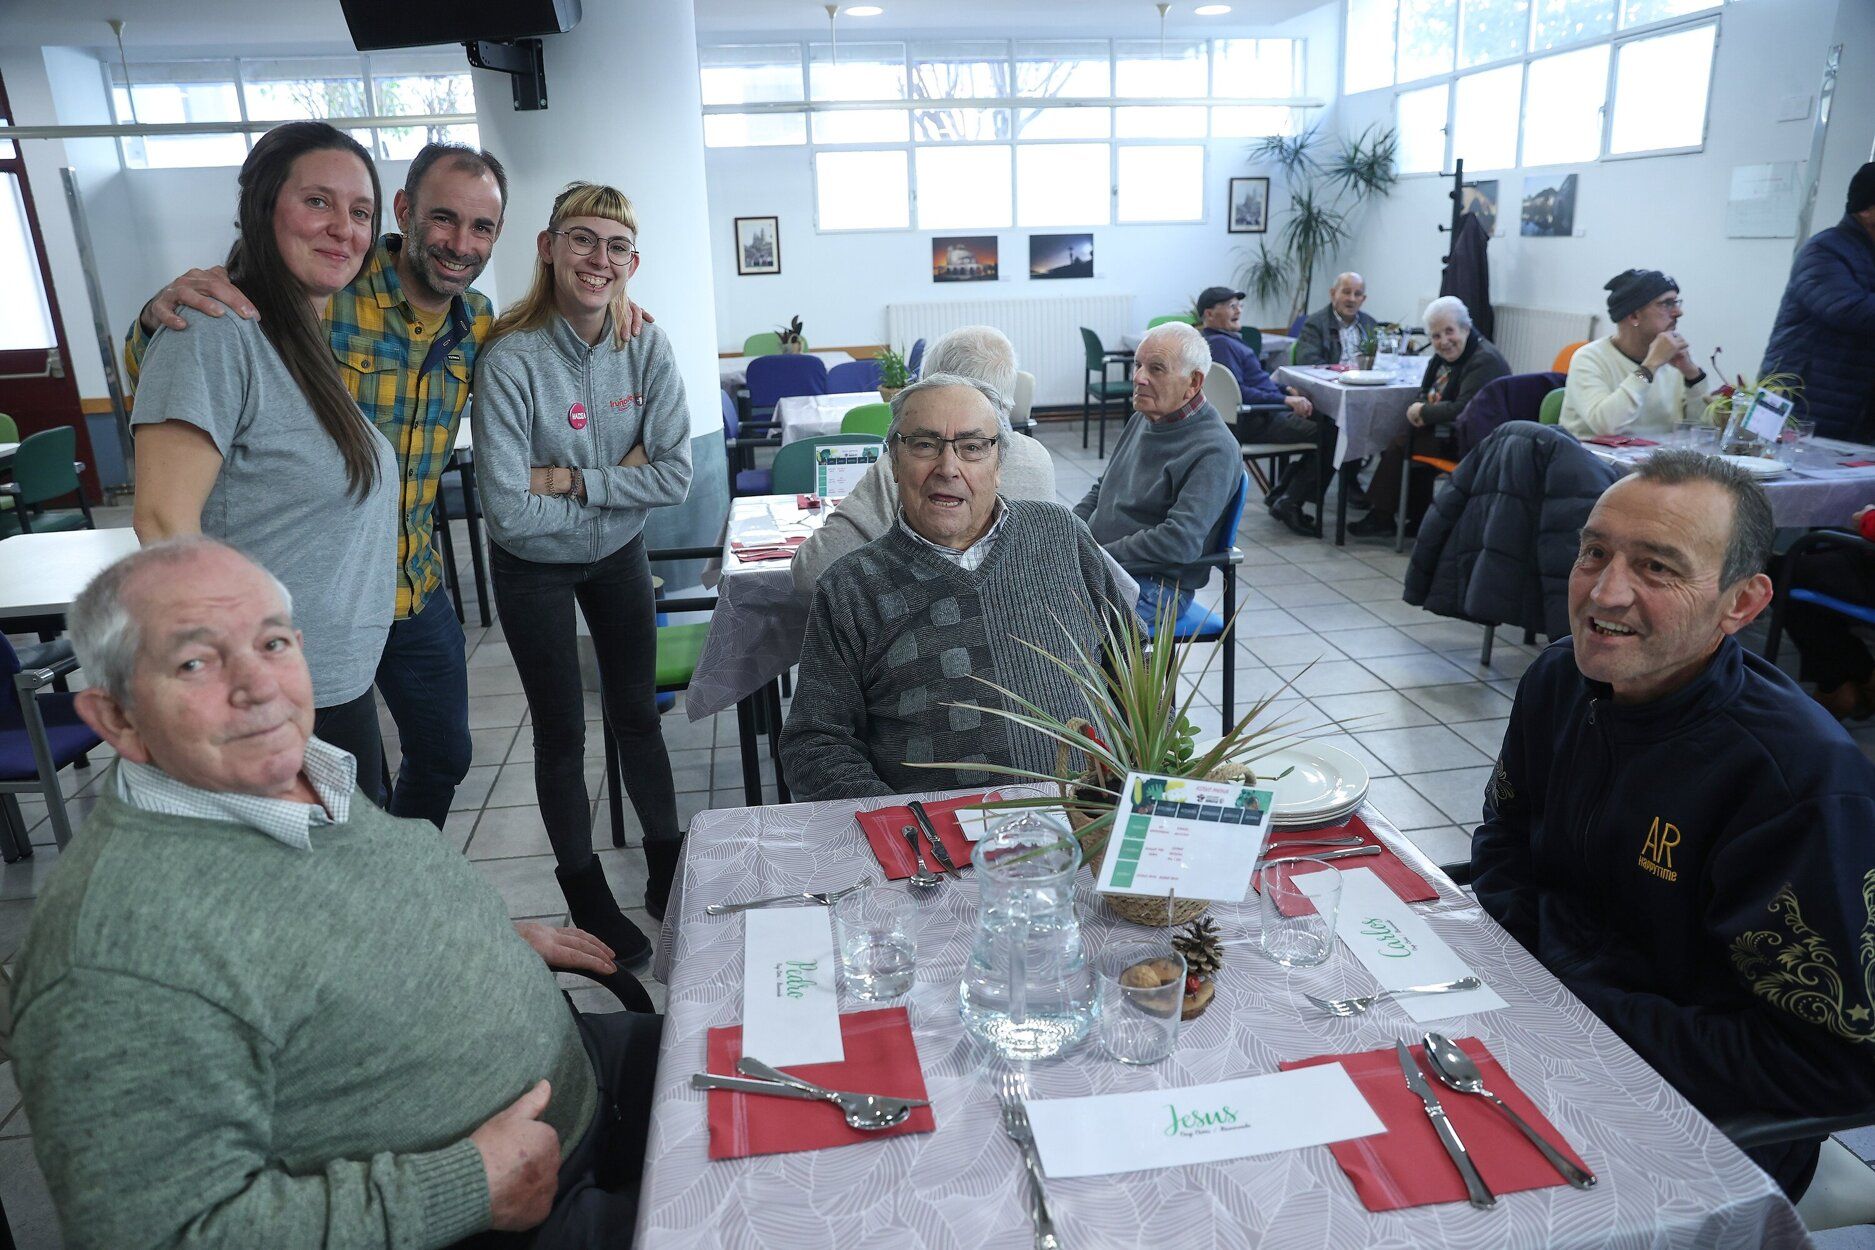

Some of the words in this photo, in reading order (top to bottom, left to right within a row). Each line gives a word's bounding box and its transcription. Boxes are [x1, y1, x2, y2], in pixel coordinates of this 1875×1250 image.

[1641, 816, 1681, 868] AR
[1360, 917, 1411, 957] Carlos
[786, 960, 818, 999] Pedro
[1163, 1103, 1239, 1137] Jesus
